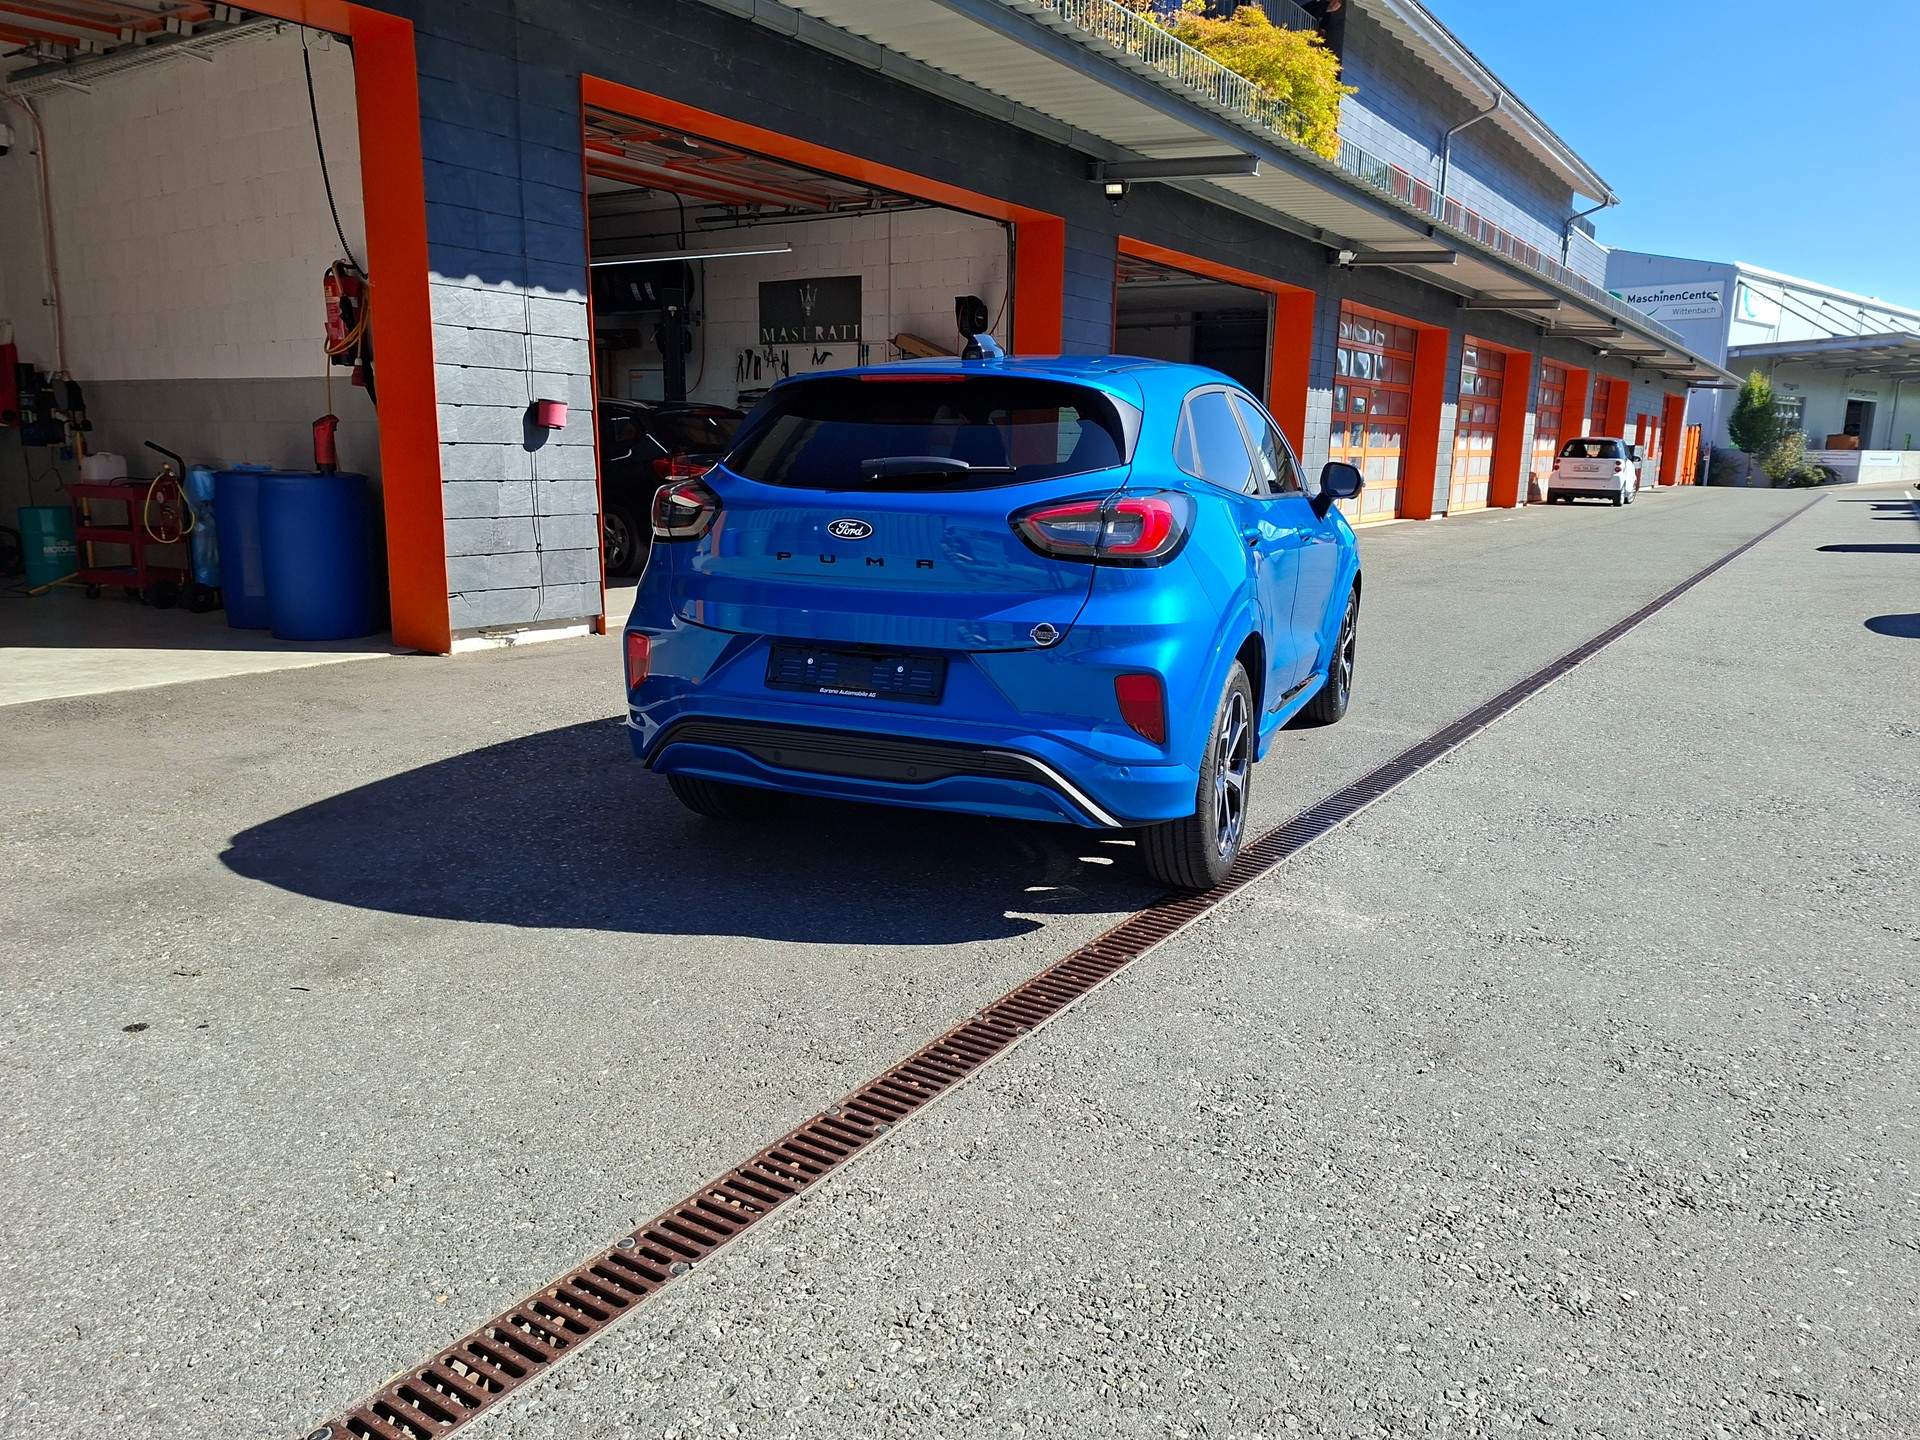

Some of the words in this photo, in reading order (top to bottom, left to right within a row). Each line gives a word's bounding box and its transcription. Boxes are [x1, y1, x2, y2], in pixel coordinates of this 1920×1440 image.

[1672, 305, 1716, 316] Wittenbach
[762, 324, 860, 343] MASERATI
[835, 521, 864, 537] Ford
[776, 551, 934, 569] PUMA
[819, 687, 839, 695] Barone
[839, 689, 868, 698] Automobile
